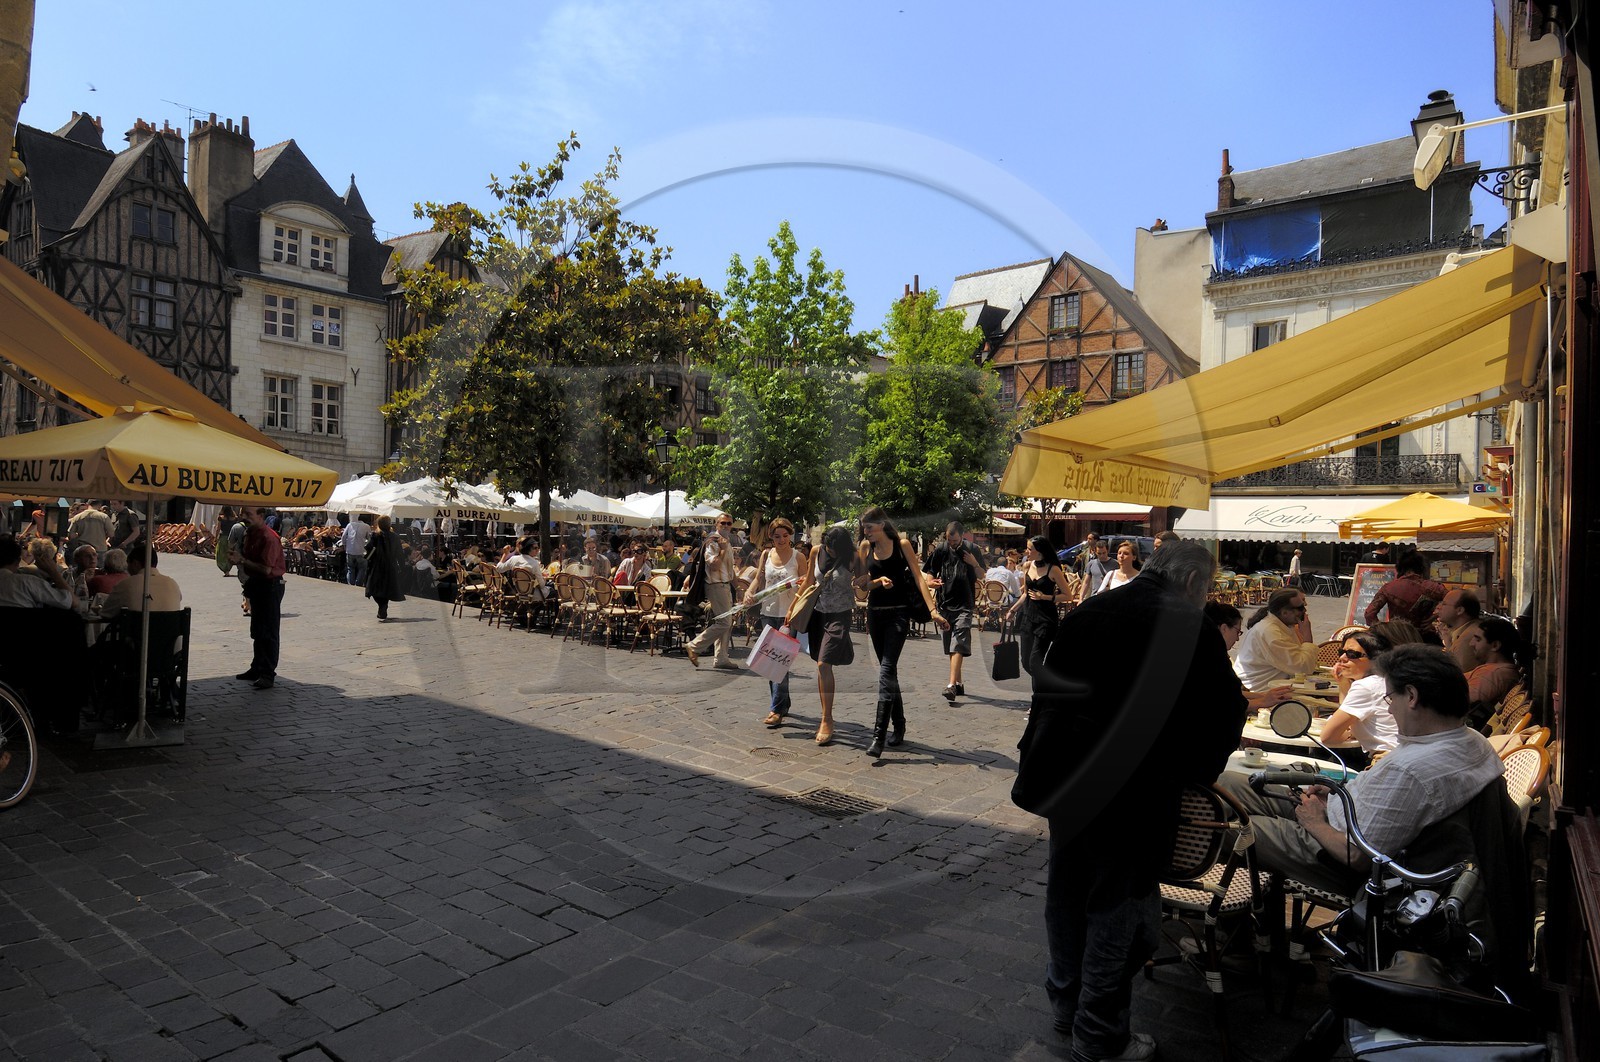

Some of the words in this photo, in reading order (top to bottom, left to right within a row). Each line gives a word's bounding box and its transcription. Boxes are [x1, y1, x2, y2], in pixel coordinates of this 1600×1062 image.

[49, 459, 84, 482] 7J/7
[128, 463, 168, 487] AU
[177, 467, 275, 497] BUREAU
[282, 477, 323, 499] 7J/7
[435, 508, 452, 519] AU
[456, 509, 502, 521] BUREAU
[575, 513, 592, 522] AU
[592, 514, 626, 525] BUREAU
[693, 517, 717, 526] BUREA
